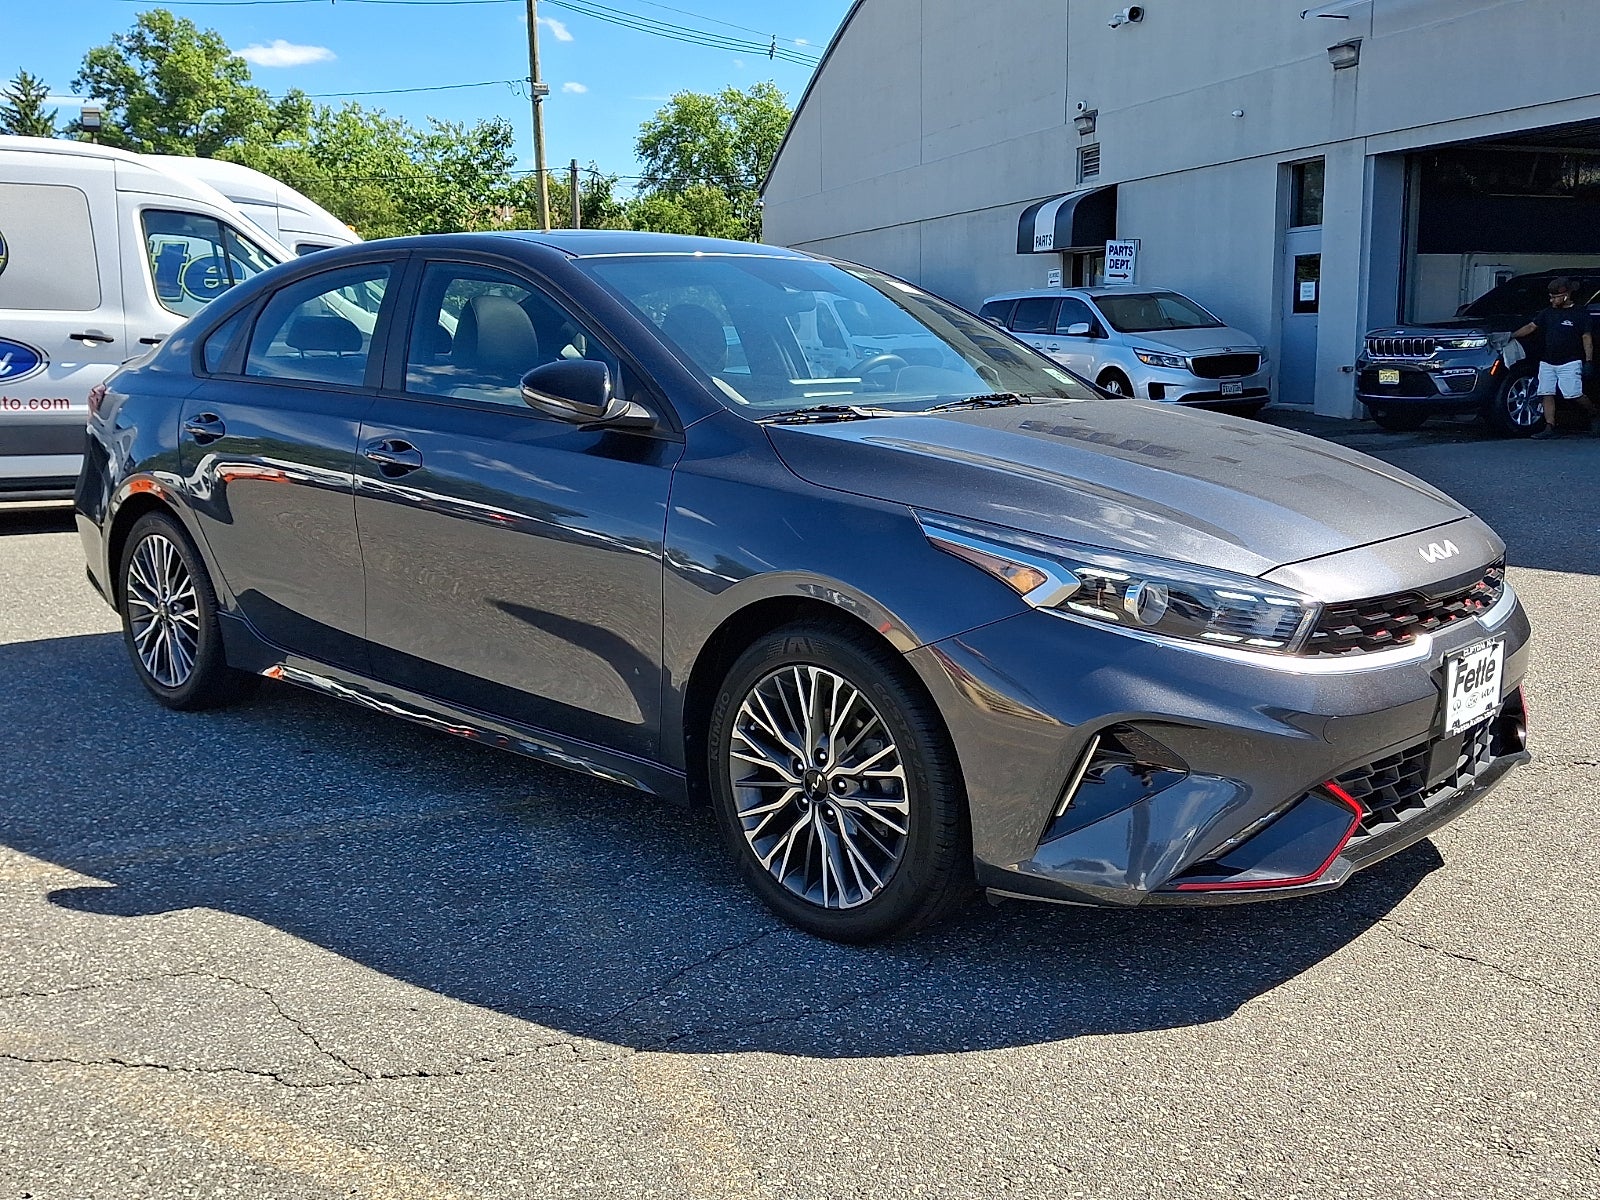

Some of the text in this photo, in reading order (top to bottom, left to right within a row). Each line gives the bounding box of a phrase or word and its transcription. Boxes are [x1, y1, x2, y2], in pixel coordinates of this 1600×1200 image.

[1035, 234, 1053, 248] PARTS
[1108, 245, 1134, 257] PARTS
[1108, 258, 1132, 270] DEPT.
[0, 395, 70, 410] to.com
[1418, 539, 1460, 564] KIA
[710, 692, 730, 761] KUMHO
